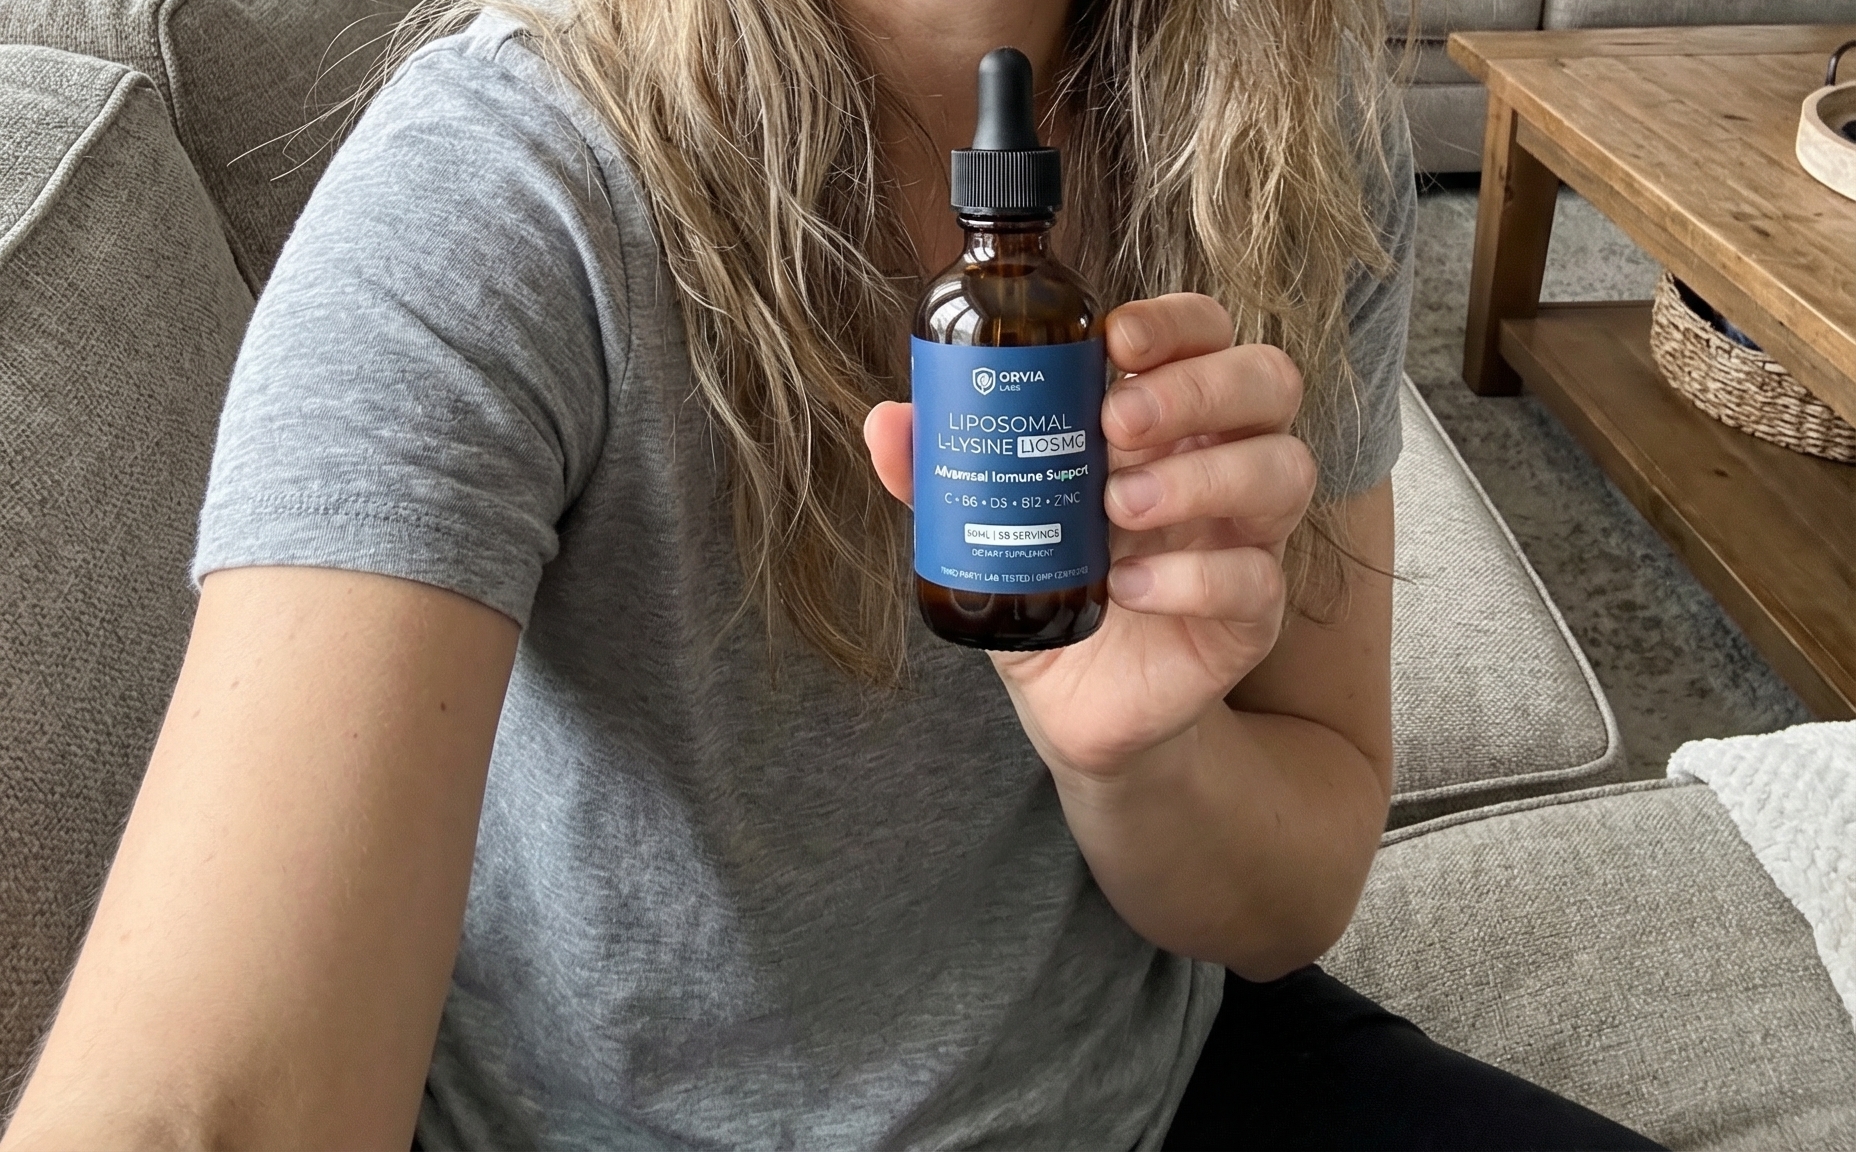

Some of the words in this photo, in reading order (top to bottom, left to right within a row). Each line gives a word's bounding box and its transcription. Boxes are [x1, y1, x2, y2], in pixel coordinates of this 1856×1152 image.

[999, 370, 1045, 383] ORVIA
[949, 412, 1072, 433] LIPOSOMAL
[938, 432, 1014, 455] L-LYSINE
